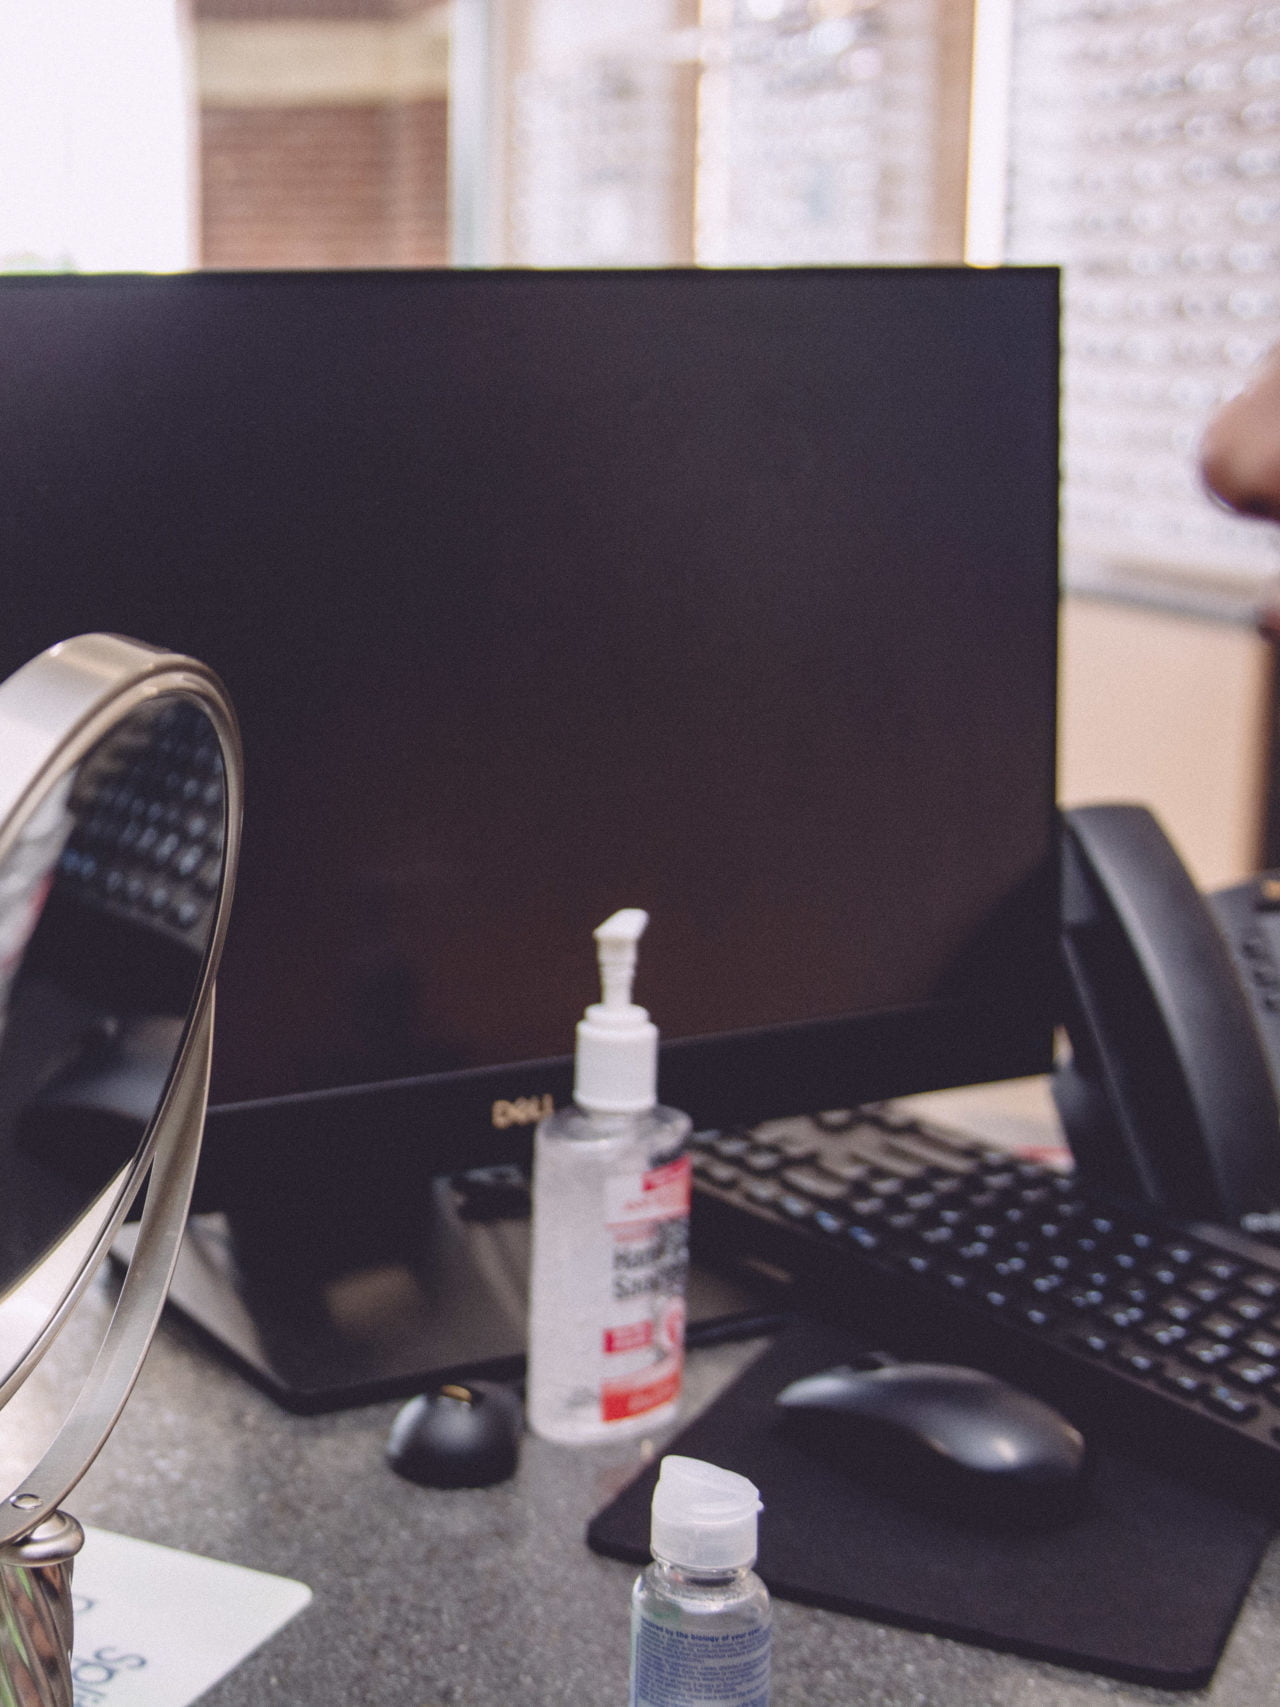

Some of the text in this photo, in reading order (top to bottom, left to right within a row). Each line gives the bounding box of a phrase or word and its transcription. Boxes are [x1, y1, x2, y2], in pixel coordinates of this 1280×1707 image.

[491, 1093, 554, 1129] DELL
[676, 1630, 689, 1640] the
[721, 1633, 730, 1641] of
[72, 1646, 148, 1707] Spli
